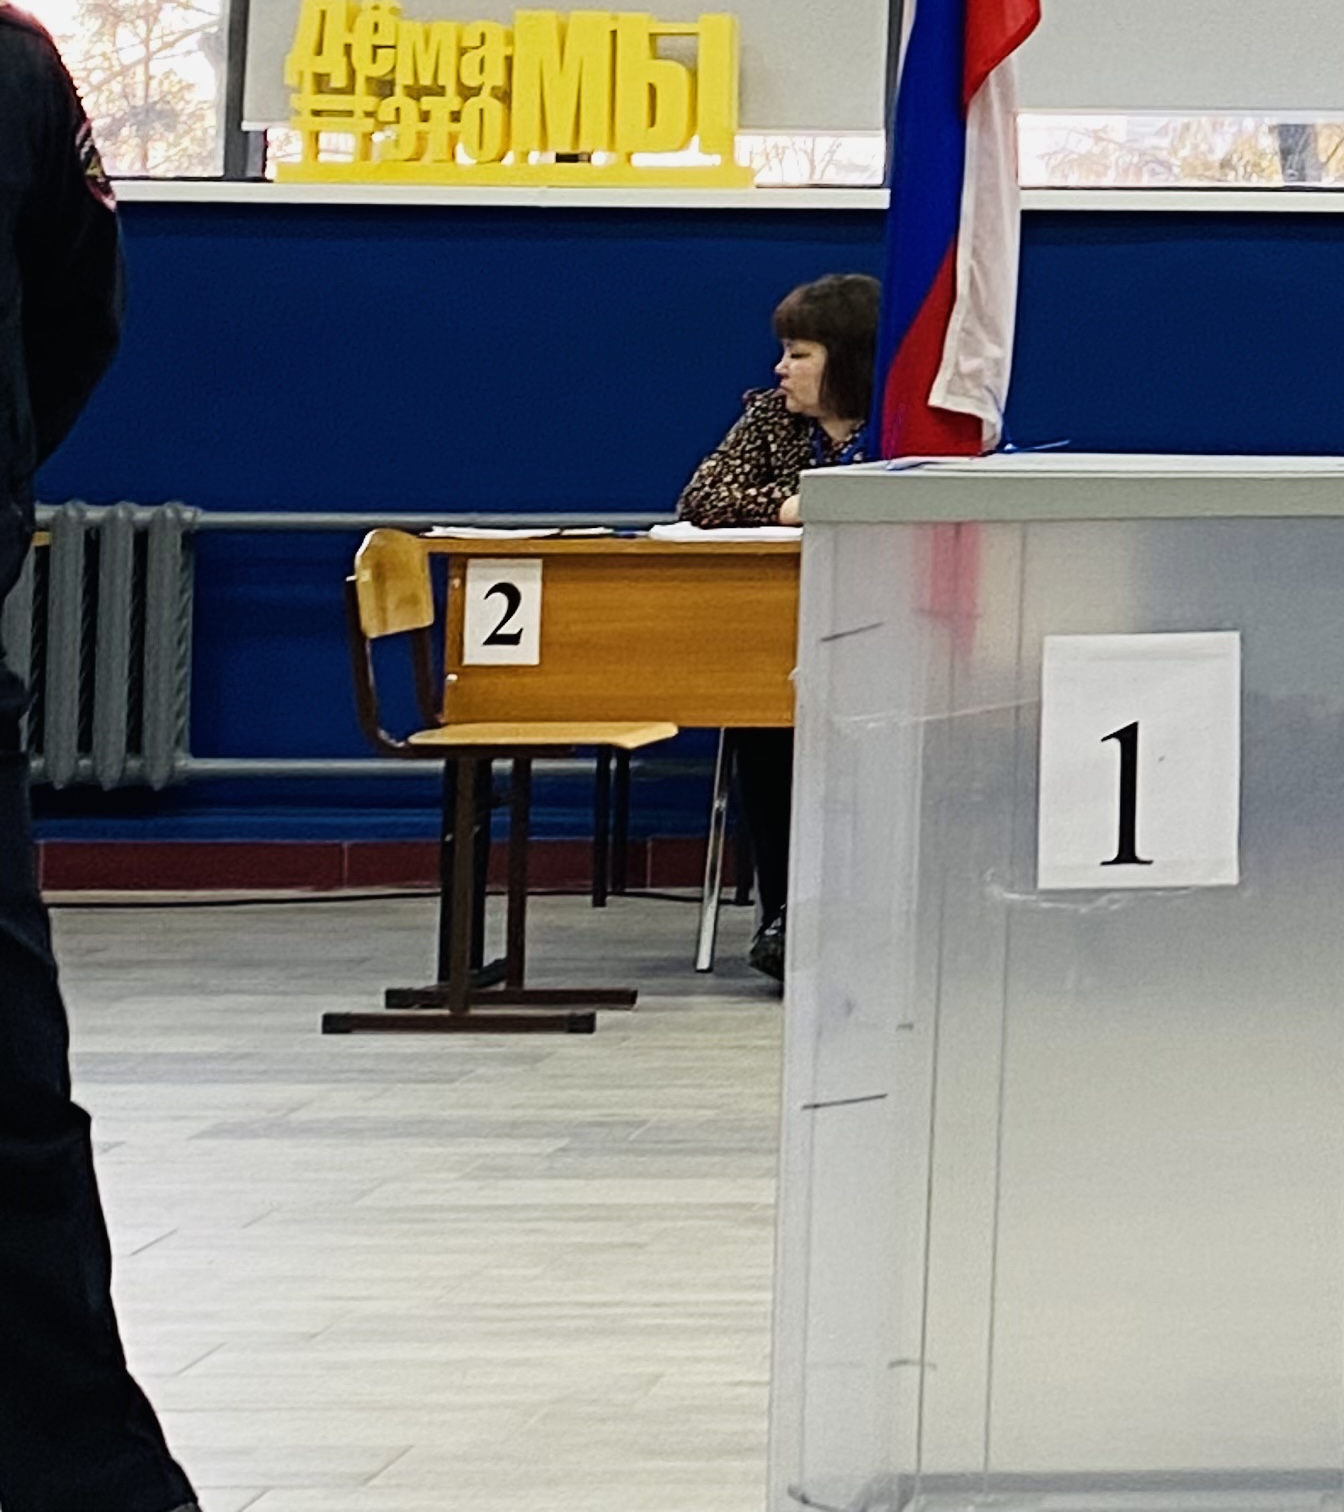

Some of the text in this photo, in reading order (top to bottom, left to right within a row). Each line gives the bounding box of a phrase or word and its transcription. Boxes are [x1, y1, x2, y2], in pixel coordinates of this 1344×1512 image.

[514, 10, 738, 155] МЫ
[483, 581, 524, 646] 2
[1101, 721, 1153, 866] 1
